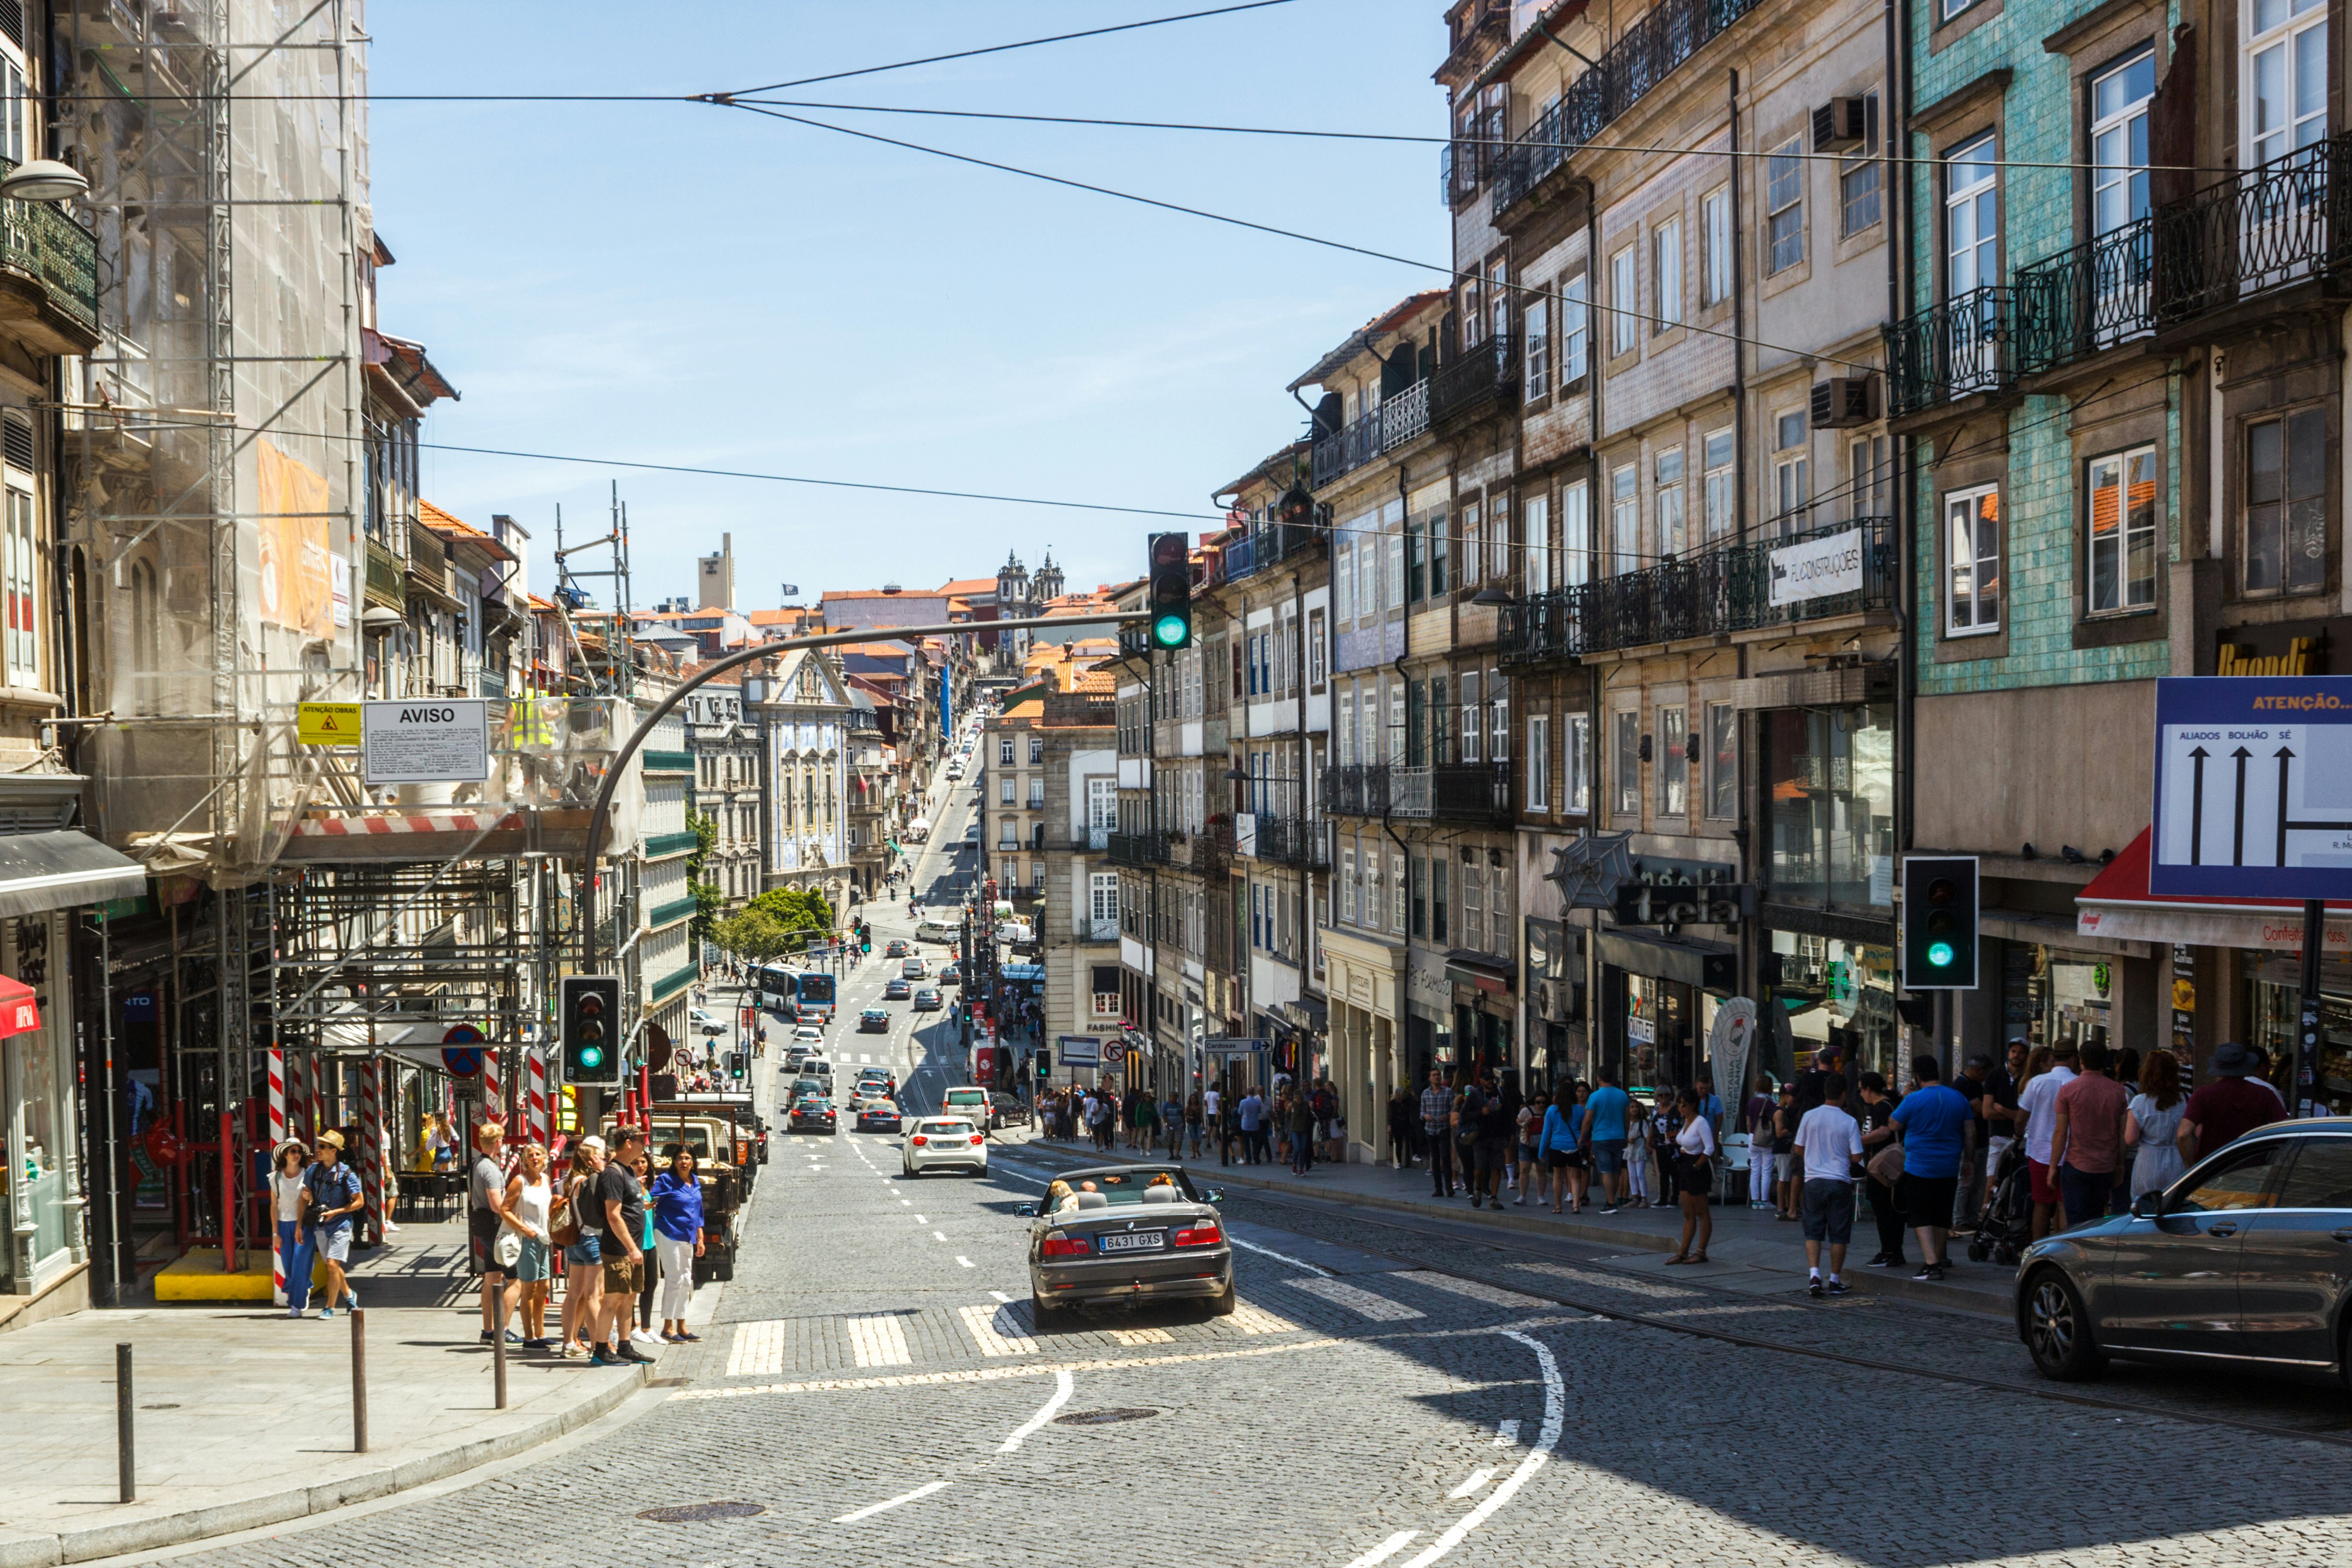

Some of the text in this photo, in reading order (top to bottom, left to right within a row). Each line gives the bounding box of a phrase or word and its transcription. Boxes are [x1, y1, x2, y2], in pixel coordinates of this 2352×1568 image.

[303, 706, 333, 714] ATENÇÃO
[400, 708, 455, 723] AVISO
[2179, 729, 2291, 740] ALIADOS BOLHÃO SÉ
[1630, 886, 1739, 924] tela
[2327, 929, 2347, 942] dos
[1628, 1018, 1654, 1041] OUTLET
[1107, 1234, 1160, 1248] 6431 GXS
